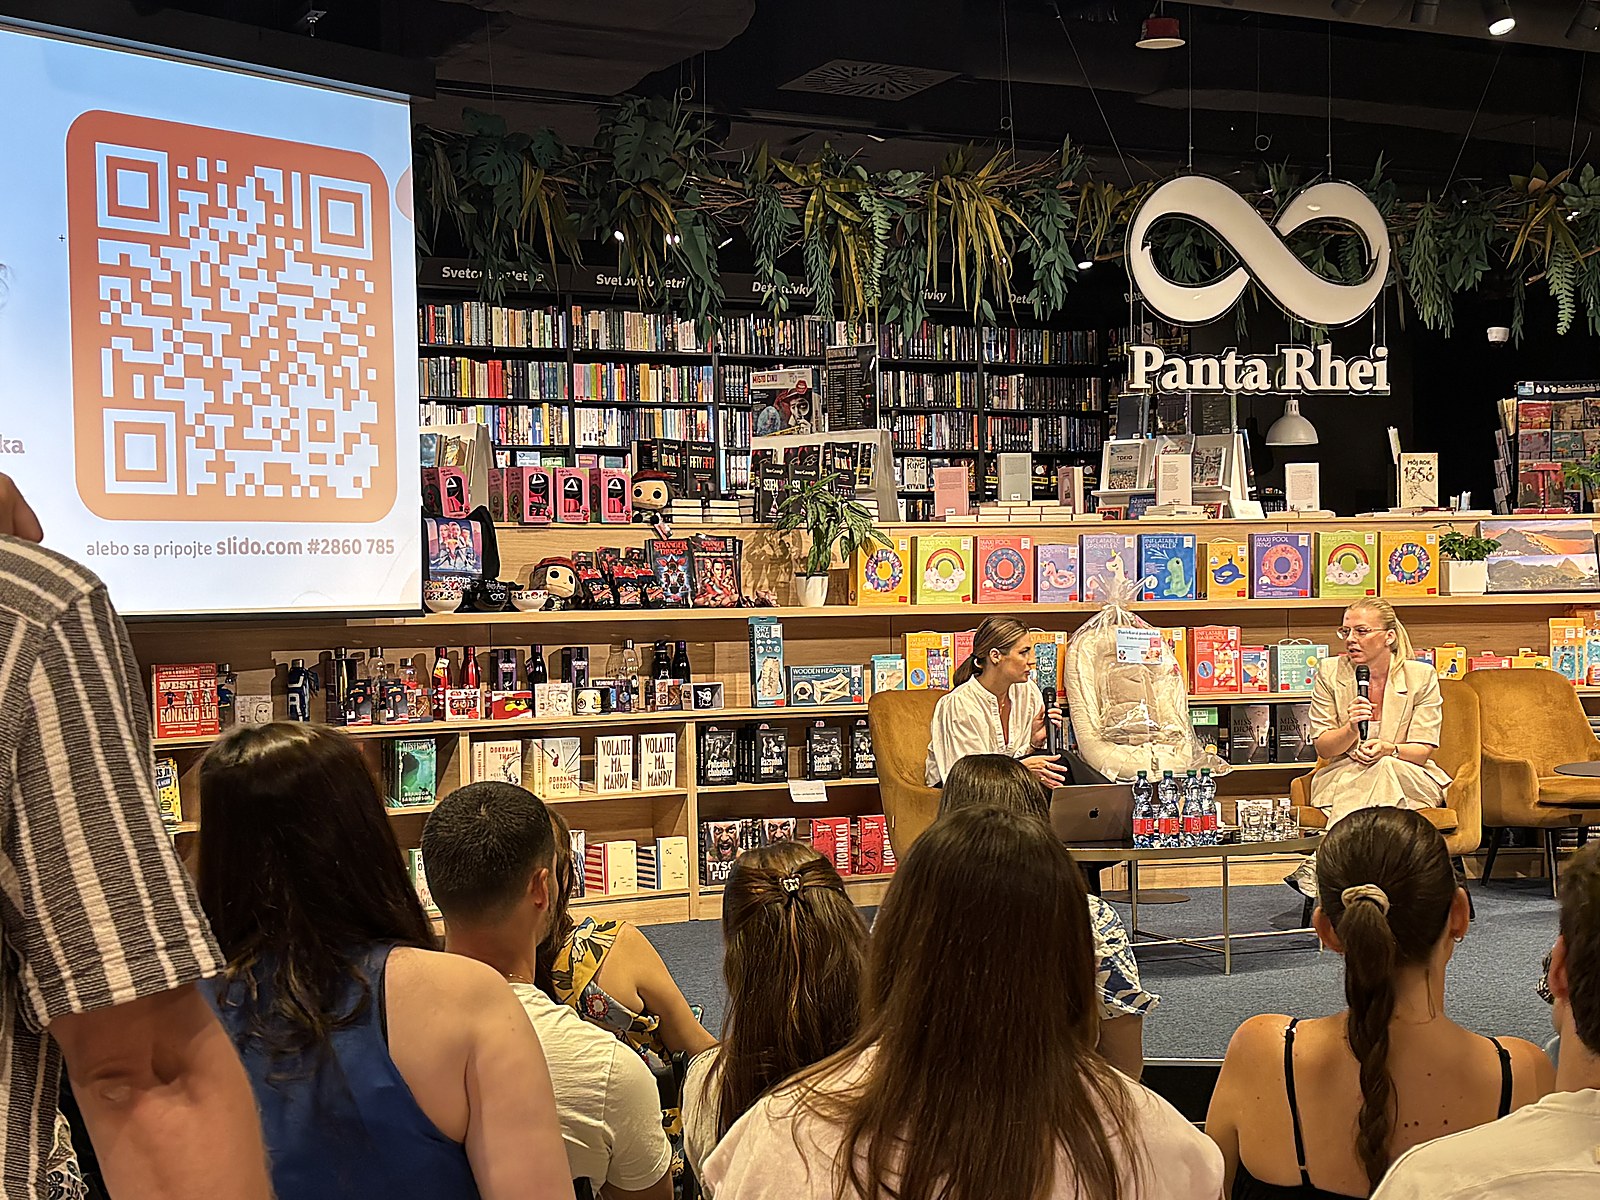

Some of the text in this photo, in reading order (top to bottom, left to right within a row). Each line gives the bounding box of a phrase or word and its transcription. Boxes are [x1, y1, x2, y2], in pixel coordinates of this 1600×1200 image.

[1129, 342, 1390, 392] Panta Rhei
[86, 537, 395, 559] alebo sa pripojte slido.com #2860 785
[159, 680, 199, 690] MESSI
[1233, 718, 1252, 726] MISS
[1279, 716, 1299, 725] MISS
[1280, 723, 1301, 732] DIOR
[1233, 725, 1254, 733] DIOR
[601, 738, 631, 757] VOLAJTE
[645, 736, 675, 754] VOLAJTE
[611, 757, 622, 773] MA
[654, 755, 665, 770] MA
[603, 773, 630, 790] MANDY
[647, 769, 673, 787] MANDY
[836, 823, 849, 869] FICOKRACIA
